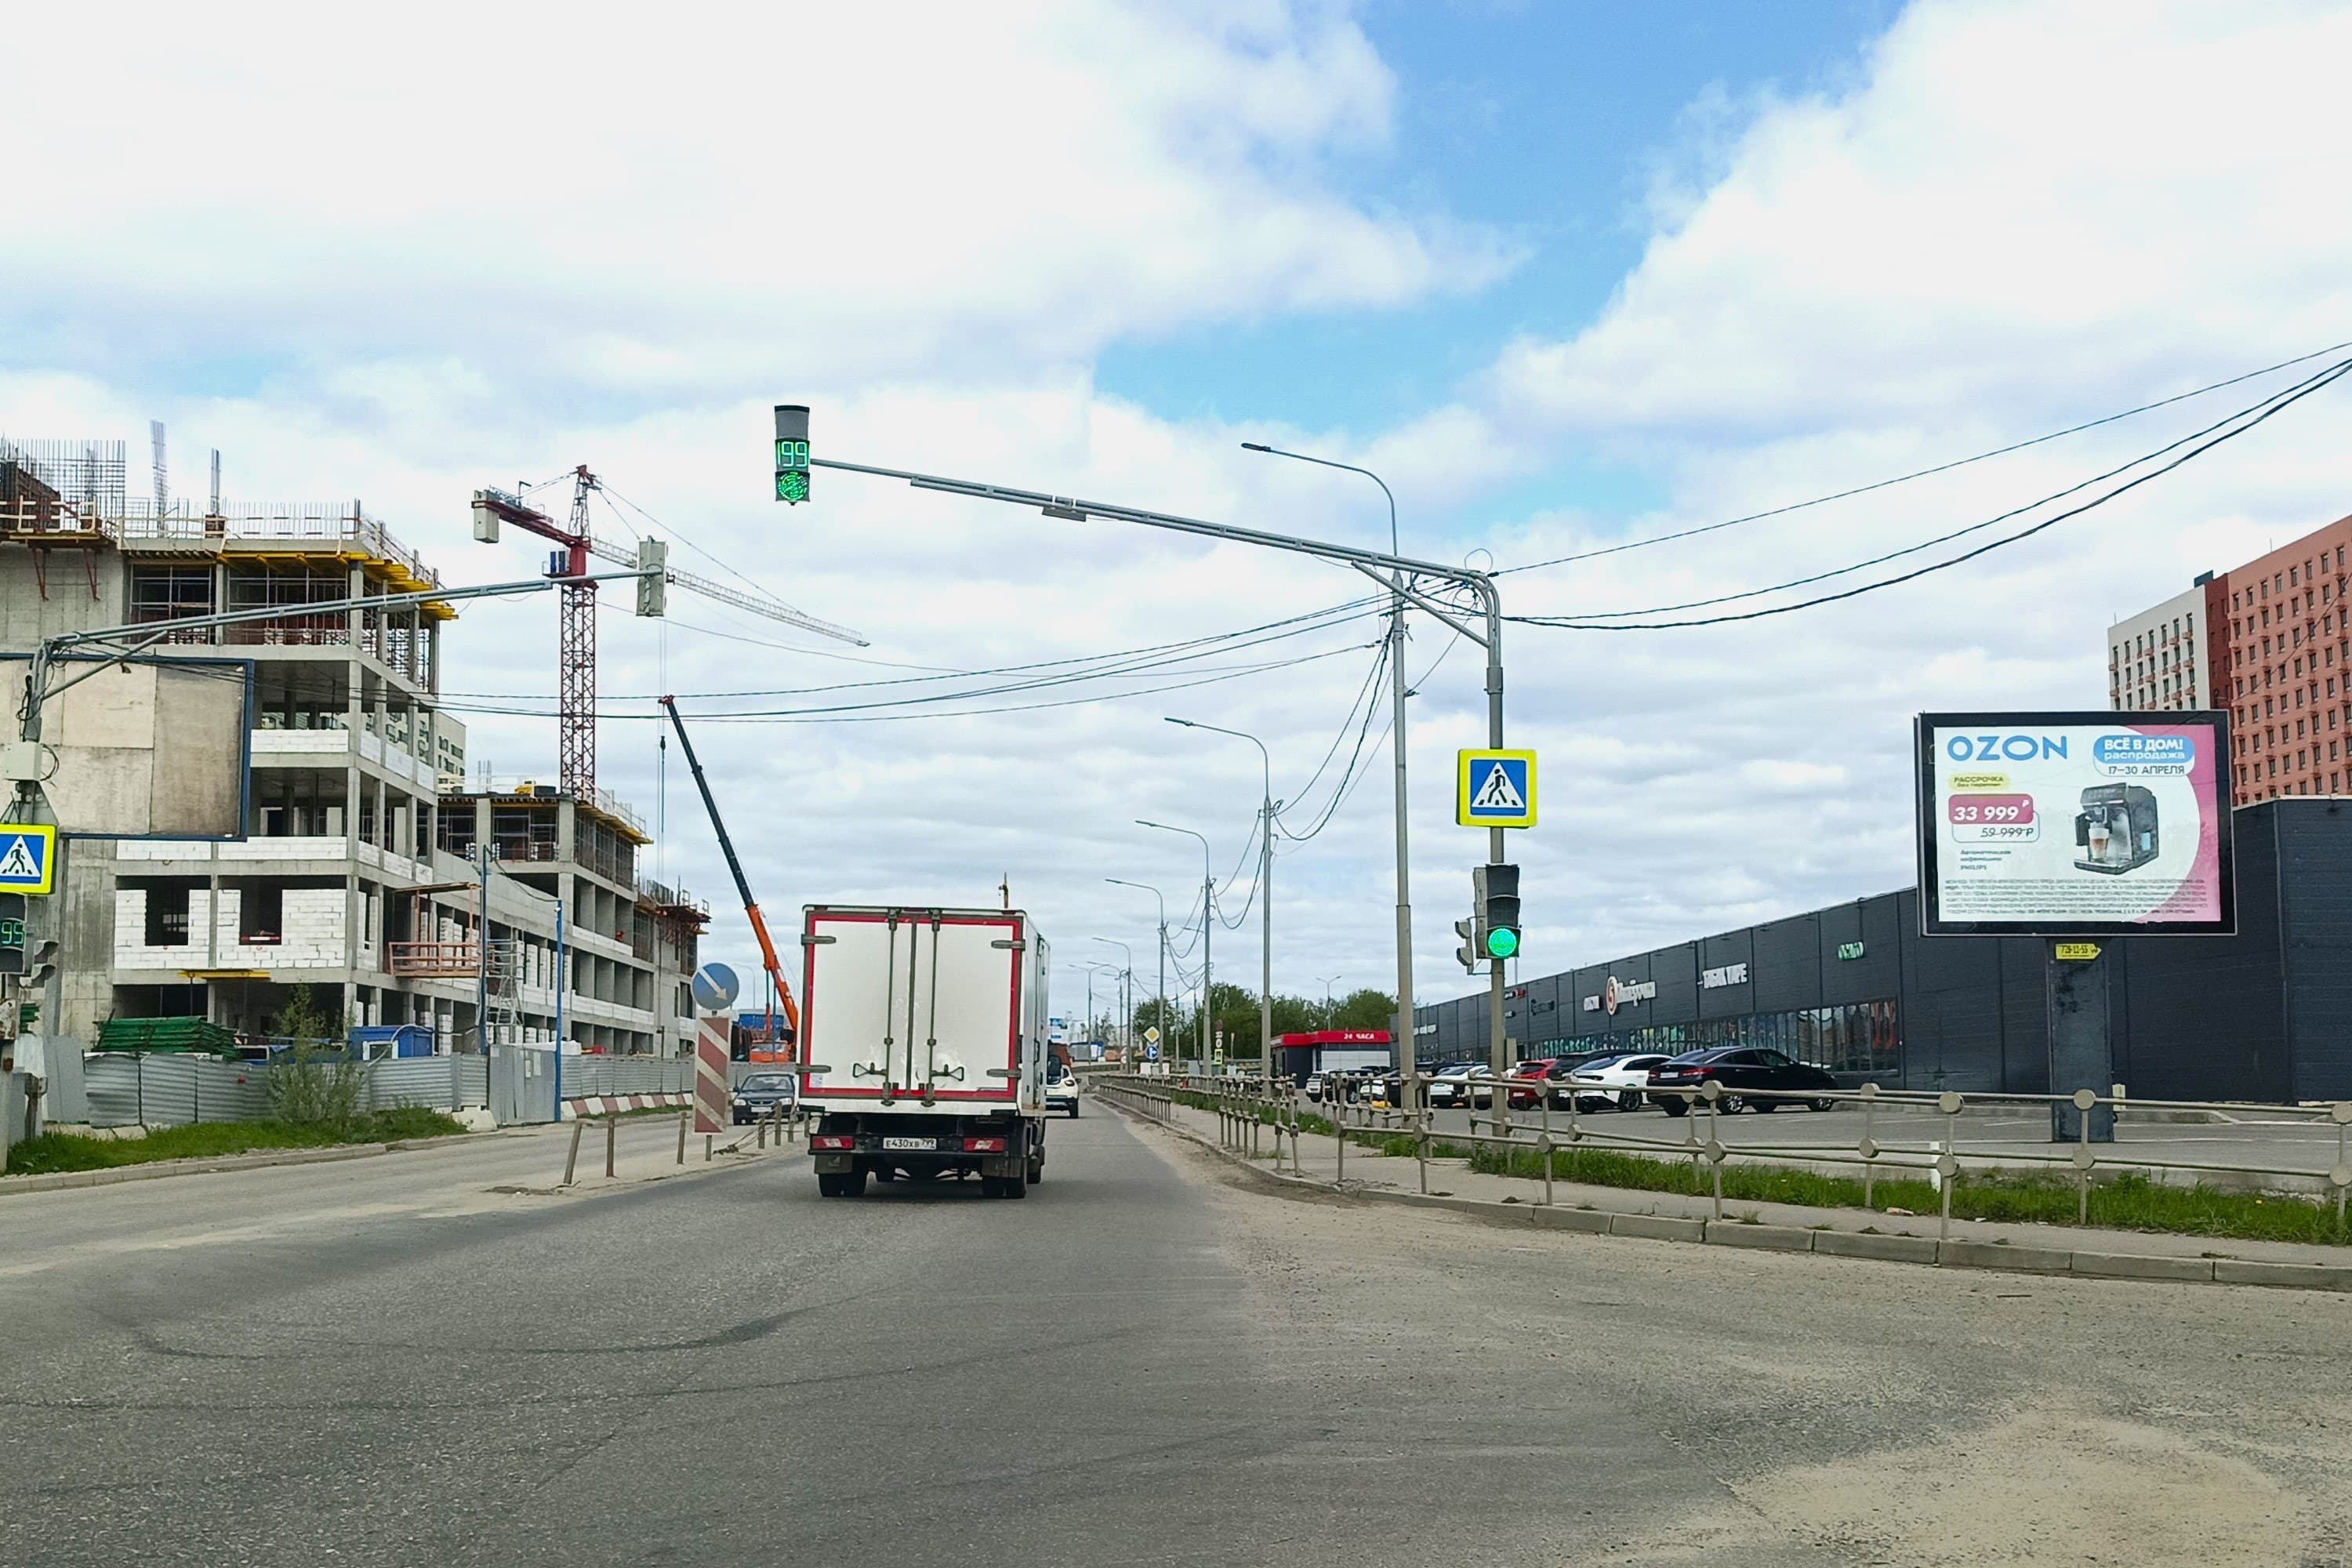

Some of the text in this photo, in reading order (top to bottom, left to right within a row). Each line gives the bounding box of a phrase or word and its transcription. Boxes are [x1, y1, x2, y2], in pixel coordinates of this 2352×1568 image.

[1947, 735, 2067, 761] OZON
[2104, 737, 2183, 752] ВСЁ В ДОМ!
[2104, 751, 2185, 761] распродажа
[2141, 765, 2184, 775] АПРЕЛЯ
[1954, 806, 1978, 821] 33
[1984, 805, 2019, 821] 999
[1980, 827, 1996, 838] 59
[2000, 827, 2023, 838] 999
